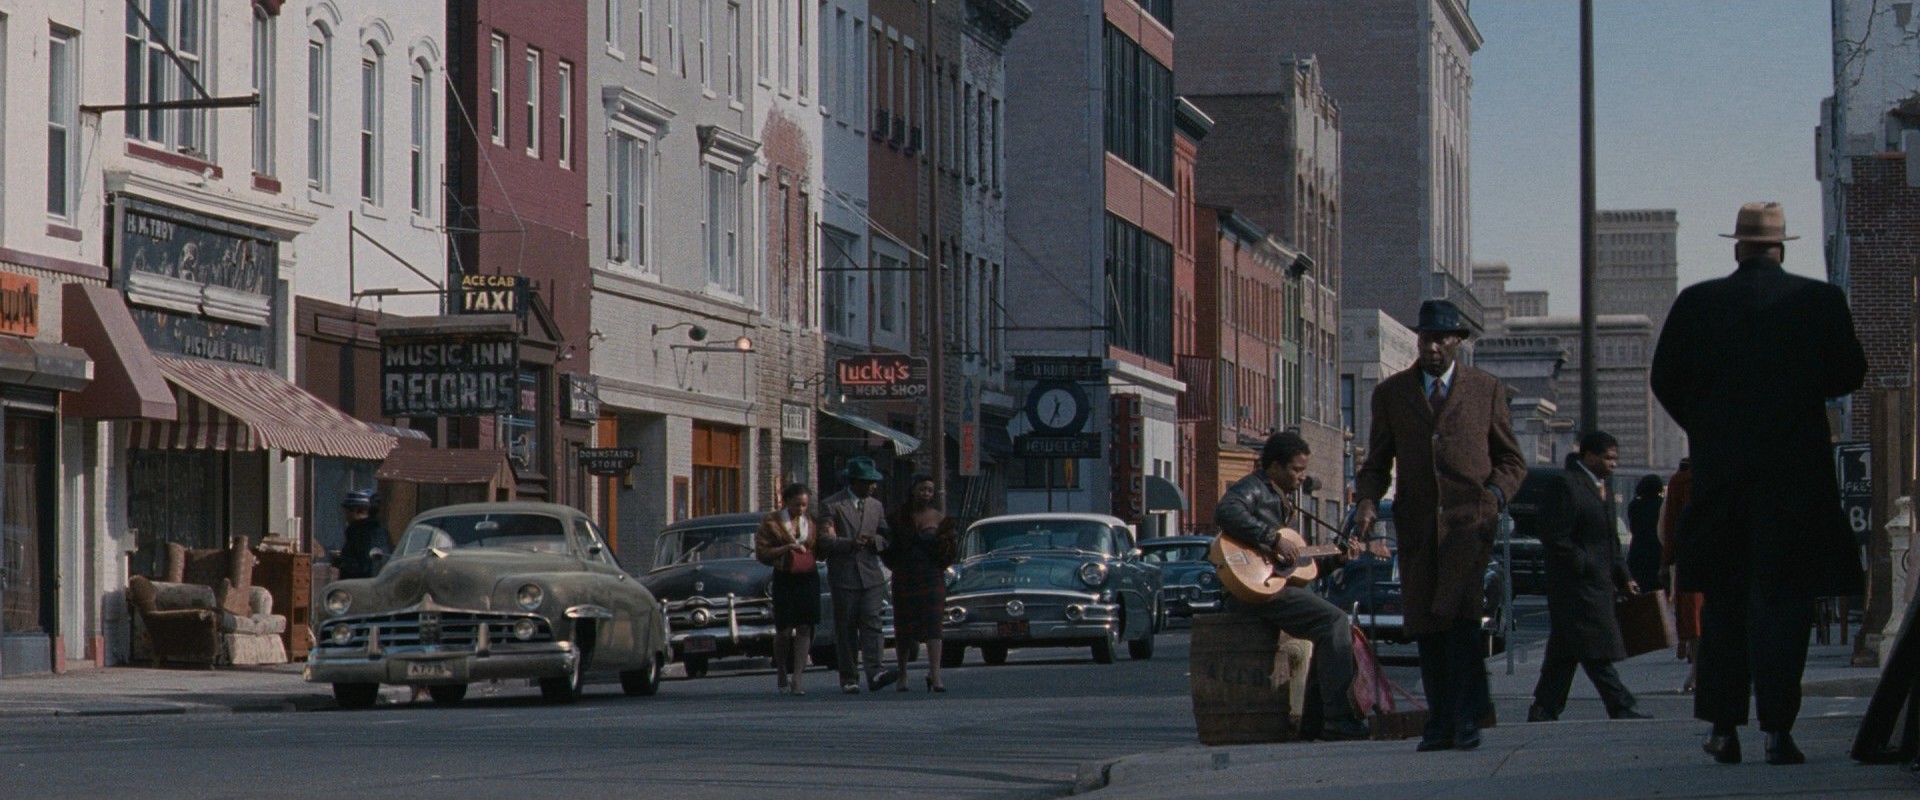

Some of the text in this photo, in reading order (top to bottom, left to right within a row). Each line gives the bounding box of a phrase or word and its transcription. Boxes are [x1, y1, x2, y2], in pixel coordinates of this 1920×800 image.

[149, 218, 176, 241] TROY
[462, 275, 515, 287] ACE CAB
[464, 290, 514, 312] TAXI
[385, 342, 513, 367] MUSIC INN
[839, 358, 911, 385] Lucky's
[385, 372, 514, 411] RECORDS
[890, 384, 926, 396] SHOP
[579, 449, 635, 459] DOWNSTAIRS
[591, 459, 623, 469] STORE
[1128, 398, 1142, 519] DRUGS
